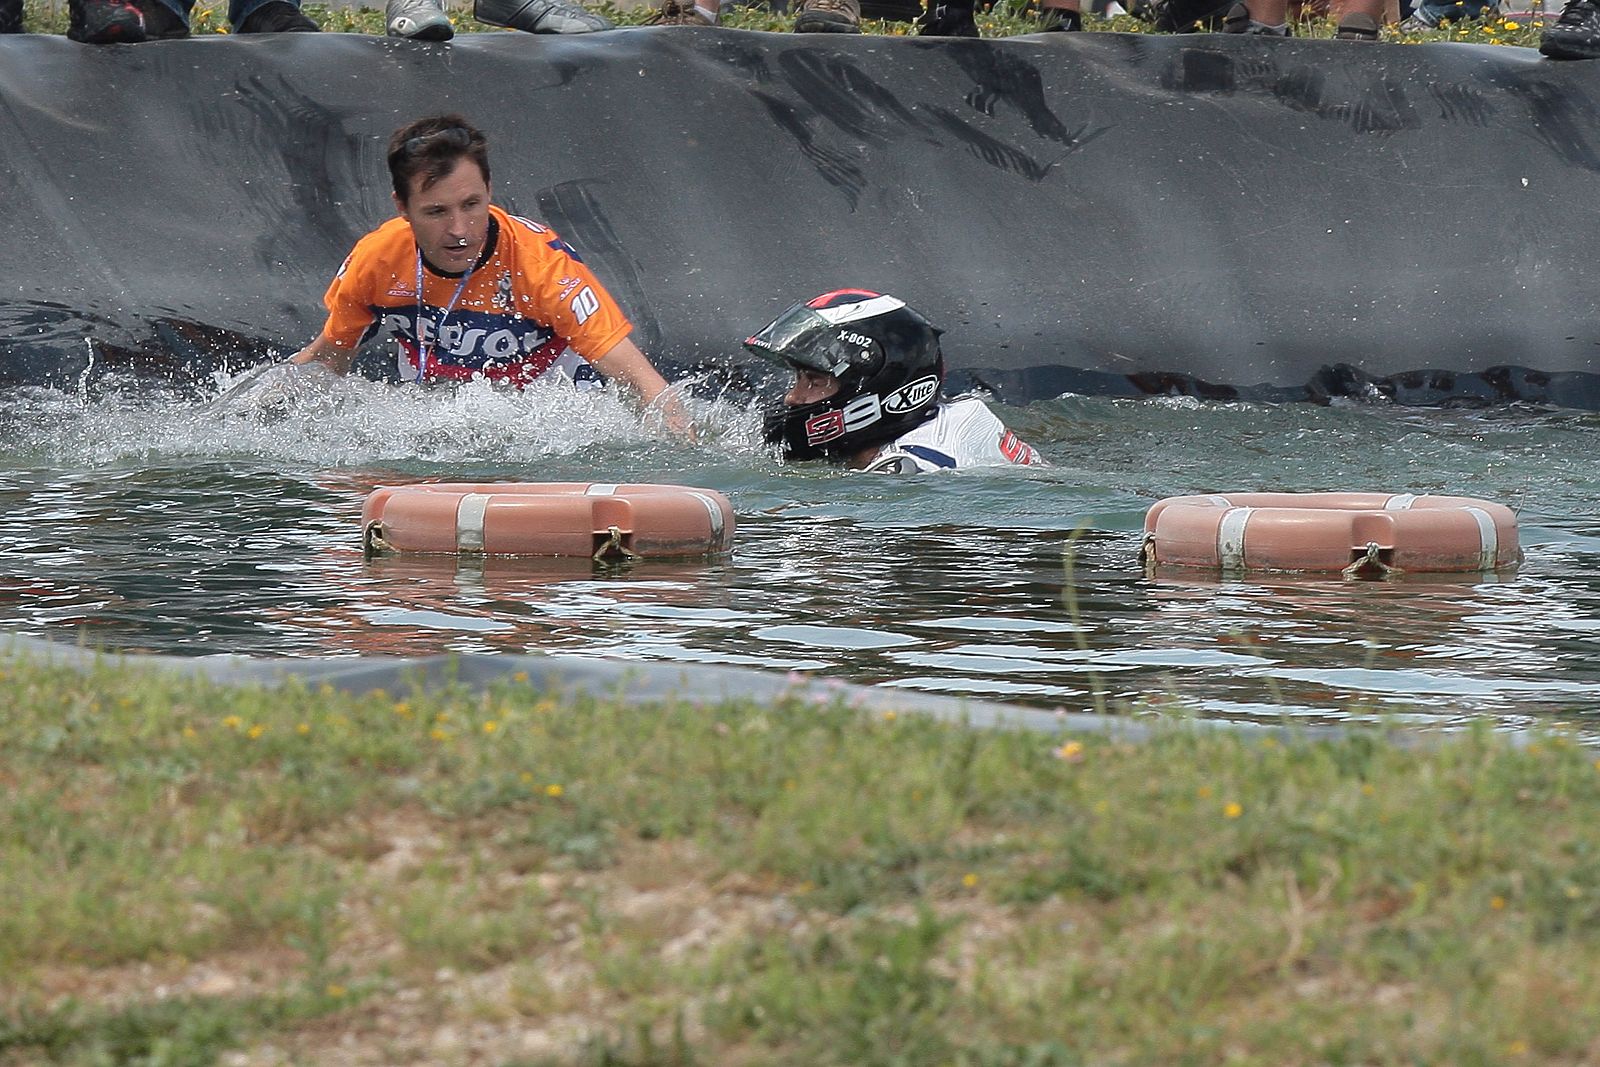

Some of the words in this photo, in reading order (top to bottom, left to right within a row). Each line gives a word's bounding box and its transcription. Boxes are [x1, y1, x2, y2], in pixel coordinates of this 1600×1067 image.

[570, 285, 600, 326] 10
[836, 329, 873, 348] X-802
[892, 381, 935, 411] X-lite
